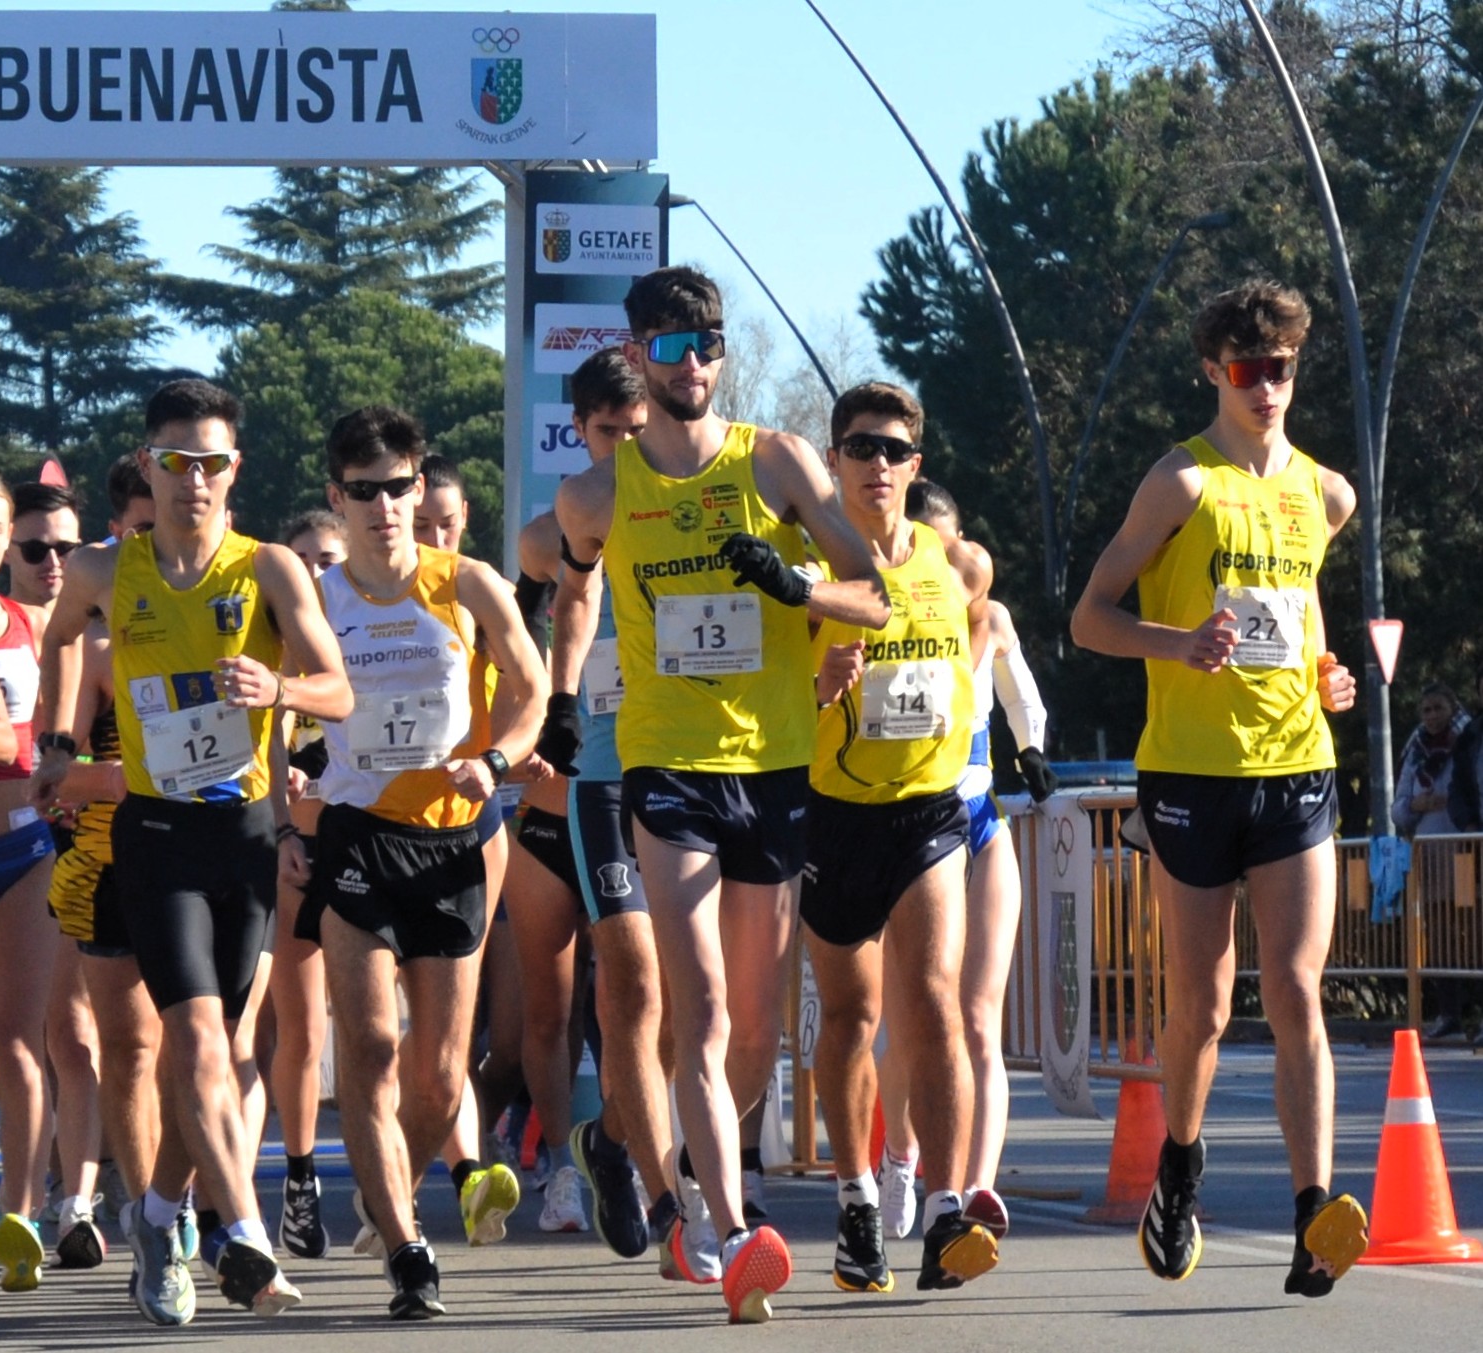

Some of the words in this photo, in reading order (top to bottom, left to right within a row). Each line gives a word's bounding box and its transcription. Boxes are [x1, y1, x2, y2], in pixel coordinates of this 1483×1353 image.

[578, 230, 653, 250] GETAFE
[579, 251, 654, 262] AYUNTAMIENTO
[540, 423, 589, 452] JO
[641, 553, 732, 579] SCORPIO-
[1221, 551, 1313, 578] SCORPIO-71
[692, 623, 727, 649] 13
[1245, 616, 1278, 641] 27
[864, 636, 960, 662] CORPIO-71
[896, 691, 926, 715] 14
[383, 720, 417, 745] 17
[183, 734, 220, 764] 12
[343, 868, 363, 882] PA
